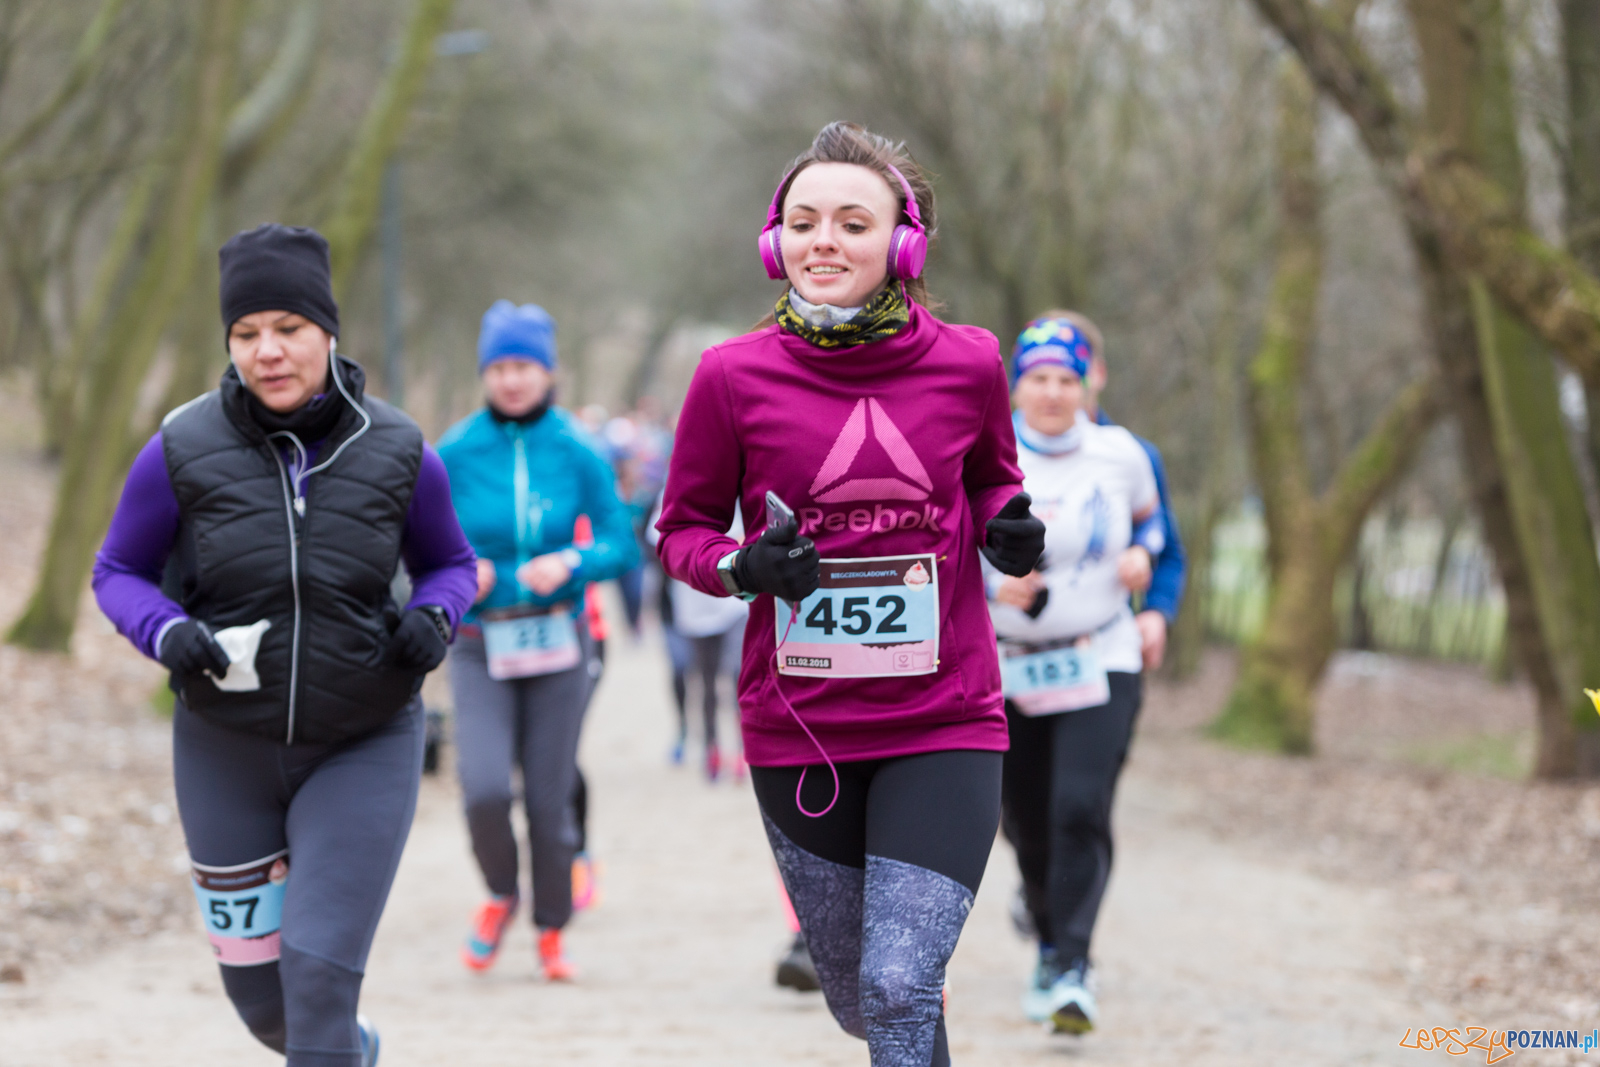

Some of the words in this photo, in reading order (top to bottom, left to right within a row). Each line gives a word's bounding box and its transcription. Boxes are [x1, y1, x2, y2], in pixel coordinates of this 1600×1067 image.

[799, 504, 940, 534] Reebok
[805, 595, 907, 636] 452
[787, 657, 829, 668] 11.02.2018
[209, 896, 260, 930] 57
